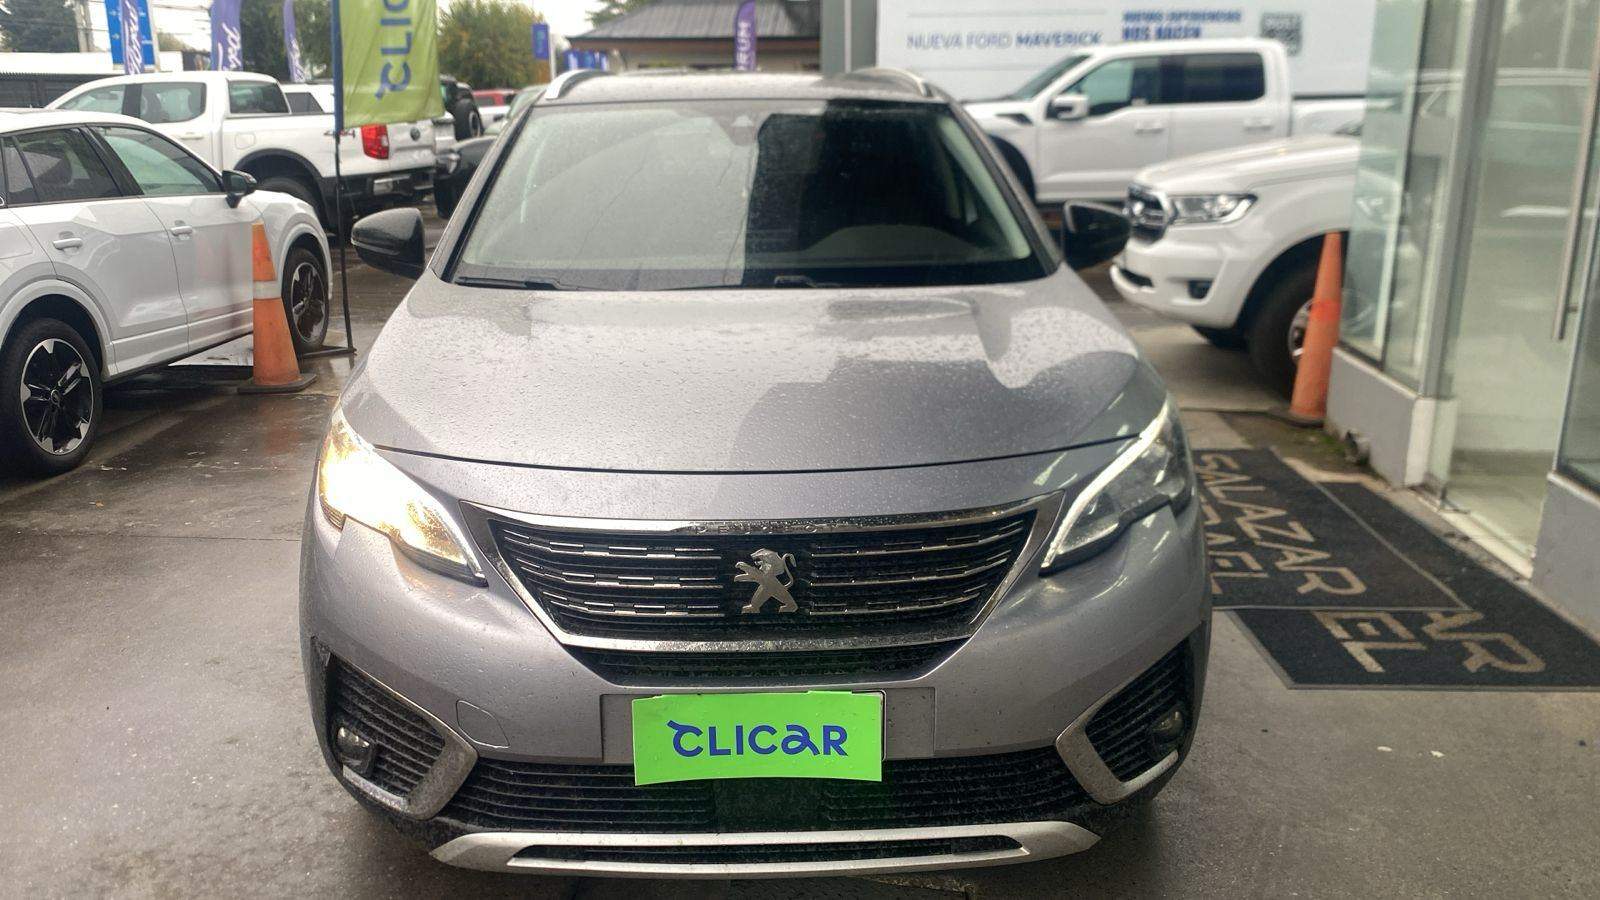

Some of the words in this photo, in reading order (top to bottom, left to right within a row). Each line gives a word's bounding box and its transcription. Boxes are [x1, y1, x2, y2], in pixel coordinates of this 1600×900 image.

[906, 32, 962, 49] NUEVA
[966, 32, 1013, 48] FORD
[1016, 31, 1102, 48] MAVERICK
[1195, 454, 1367, 595] SALAZAR
[667, 720, 848, 757] CLICAR
